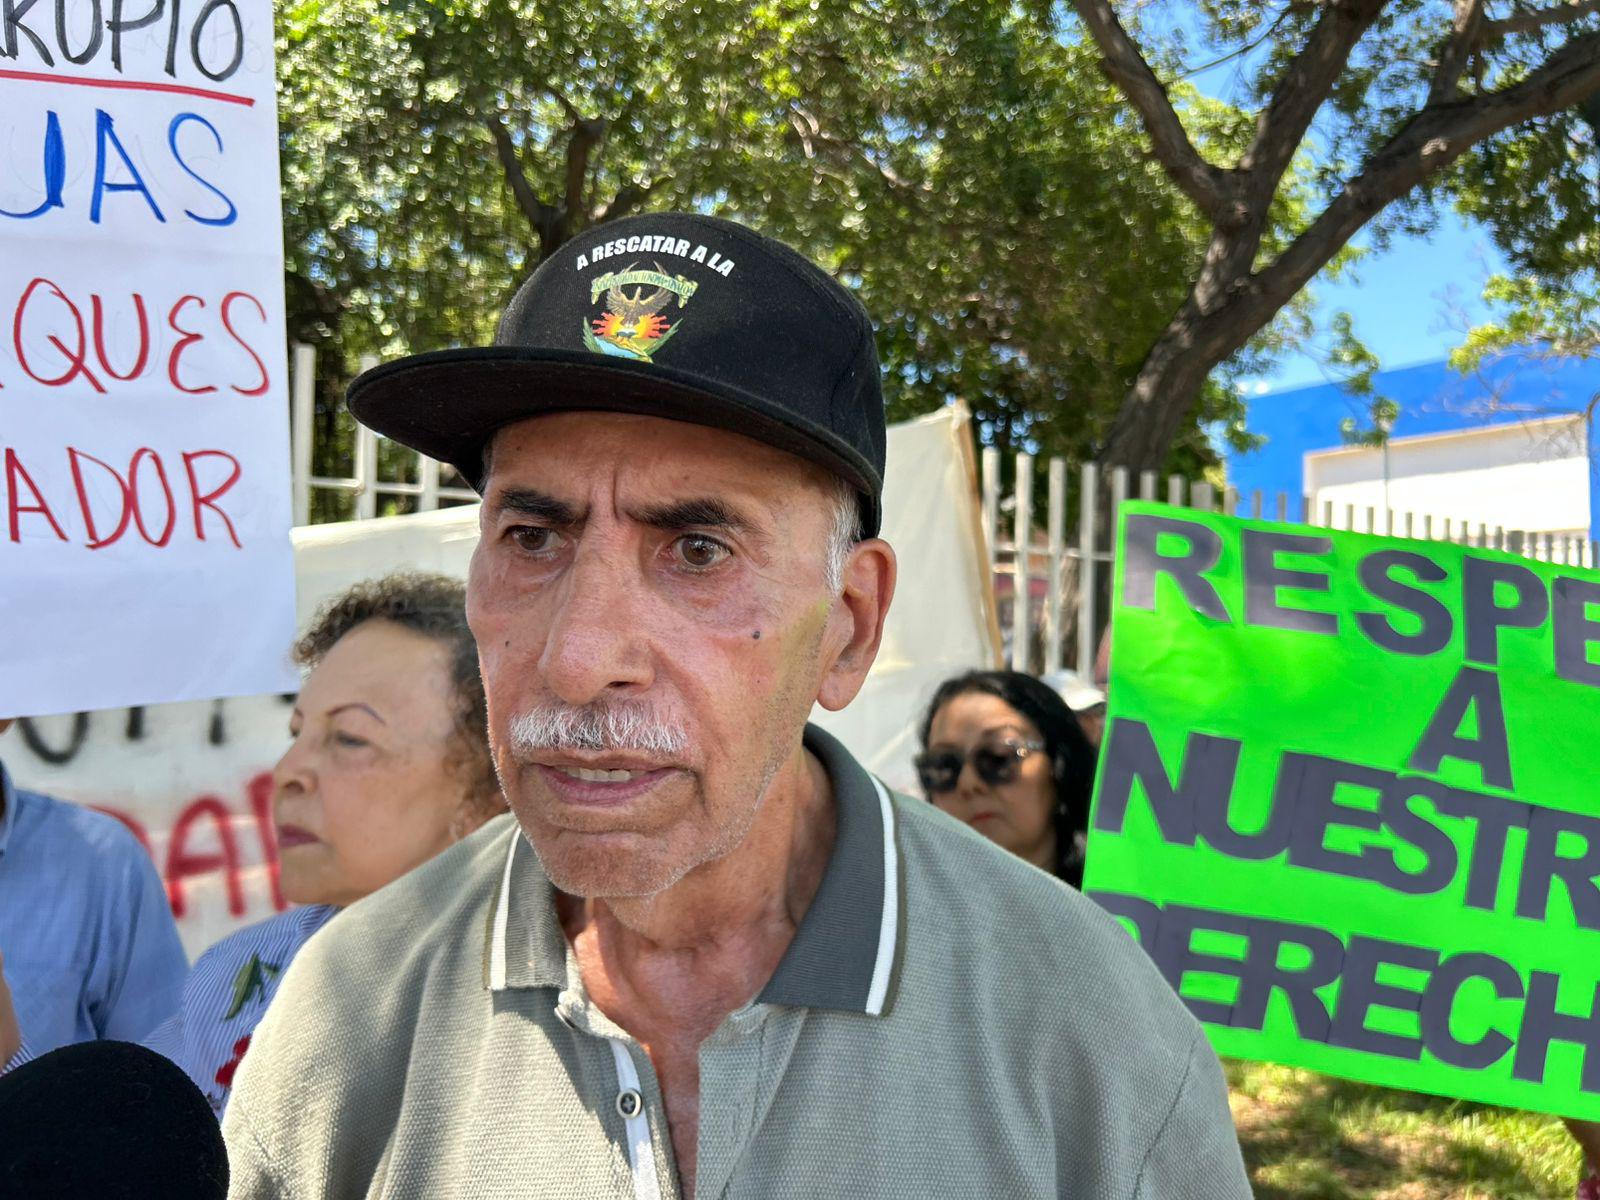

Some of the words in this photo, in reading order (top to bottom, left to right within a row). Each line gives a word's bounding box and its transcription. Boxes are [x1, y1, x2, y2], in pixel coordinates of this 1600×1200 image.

[576, 254, 589, 271] A
[592, 235, 691, 262] RESCATAR
[690, 245, 708, 264] A
[707, 253, 735, 277] LA
[0, 278, 270, 397] QUES
[5, 447, 243, 550] ADOR
[1407, 666, 1514, 792] A
[1094, 717, 1600, 930] NUESTR
